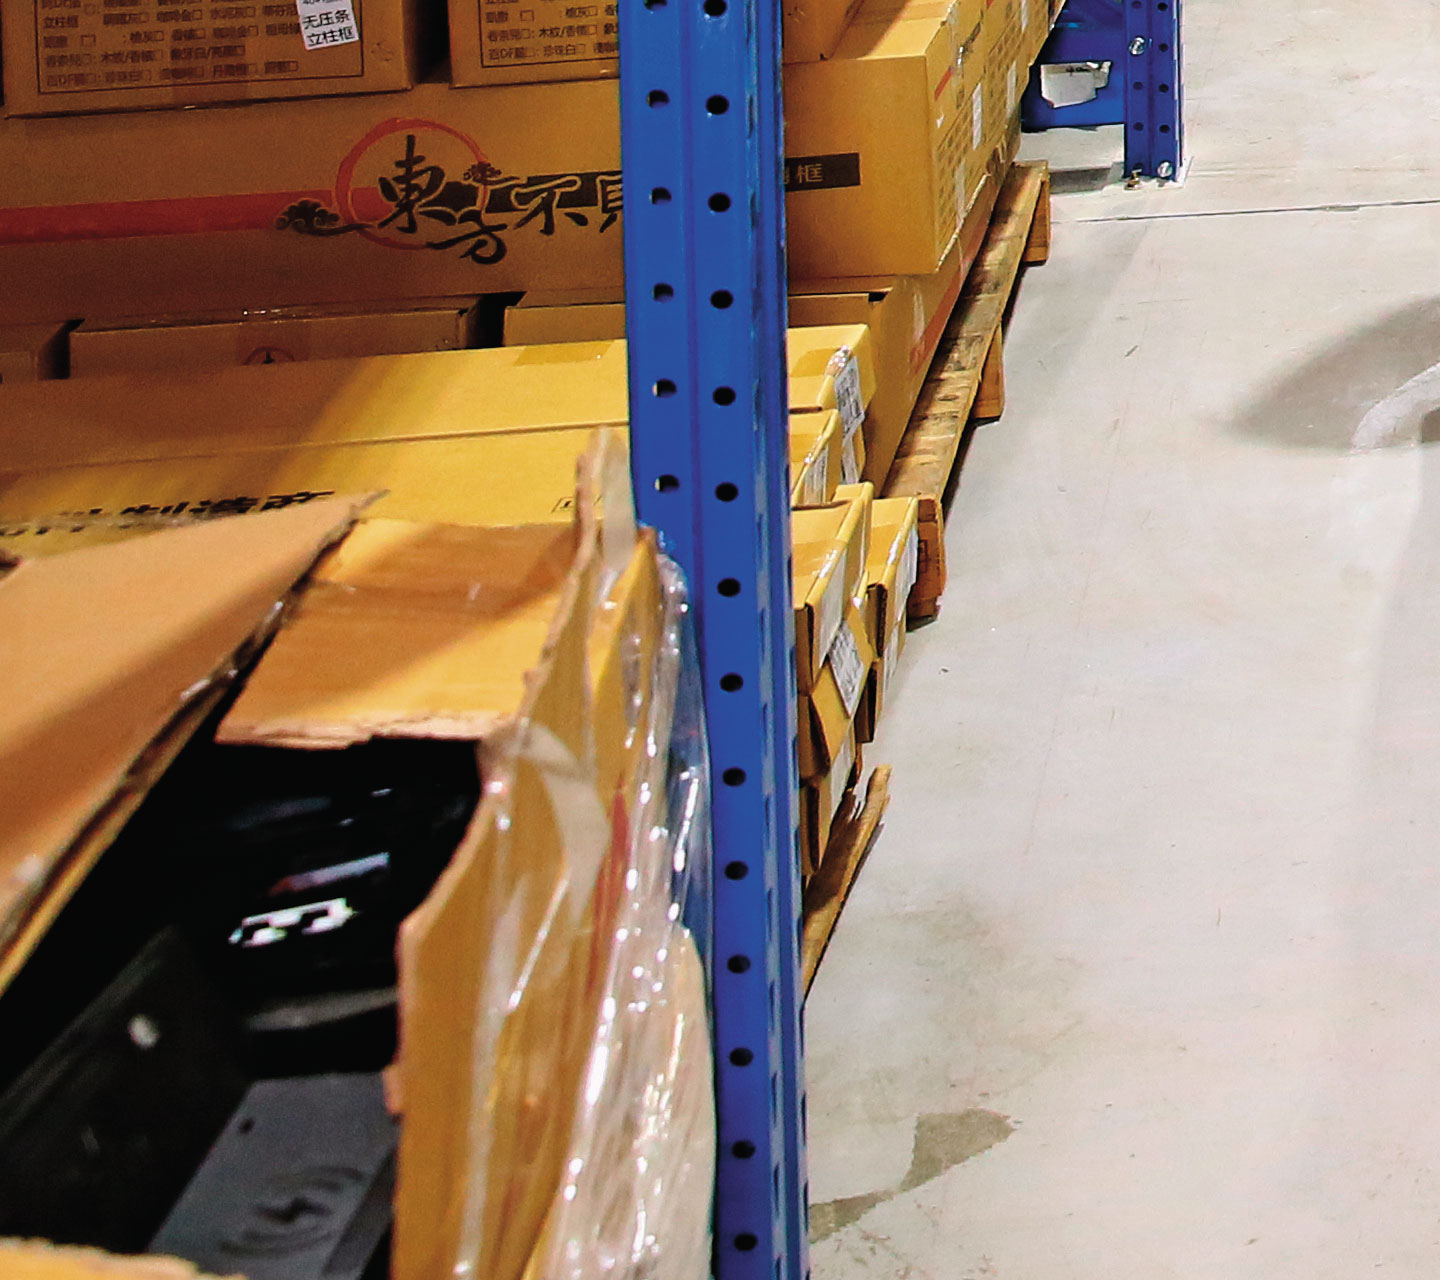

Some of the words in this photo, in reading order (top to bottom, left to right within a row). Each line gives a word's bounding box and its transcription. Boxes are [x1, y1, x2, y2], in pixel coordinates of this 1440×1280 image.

[303, 10, 351, 29] 无压条
[307, 26, 354, 46] 立柱框
